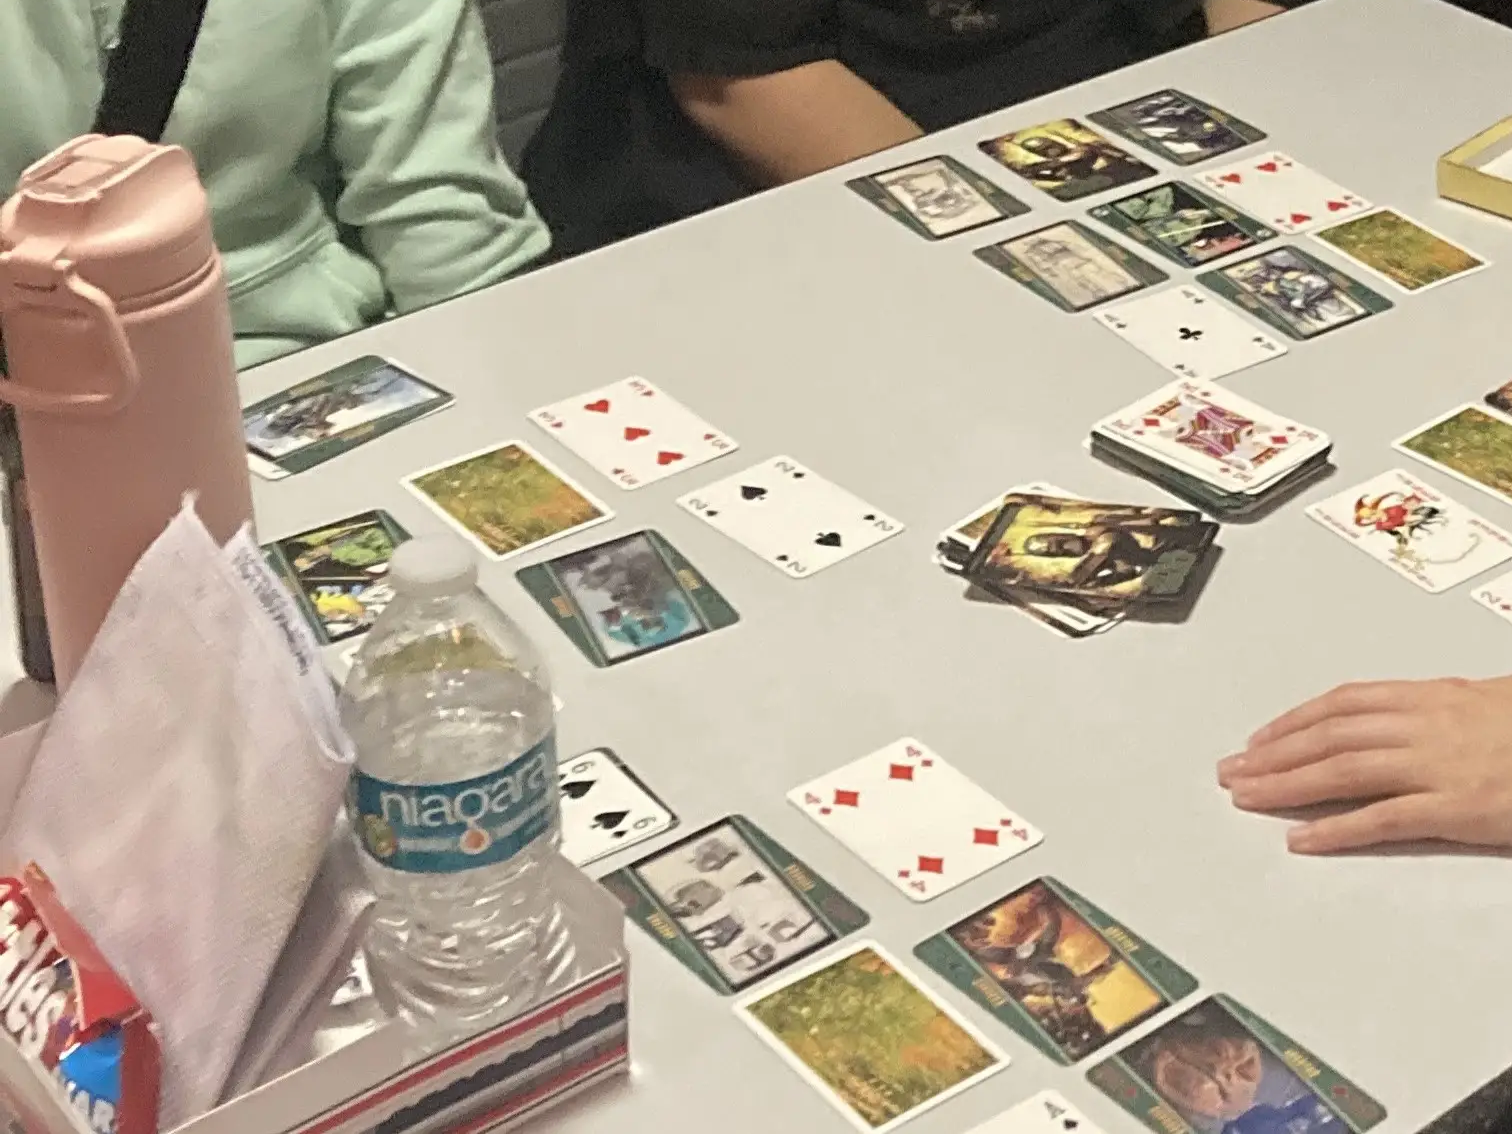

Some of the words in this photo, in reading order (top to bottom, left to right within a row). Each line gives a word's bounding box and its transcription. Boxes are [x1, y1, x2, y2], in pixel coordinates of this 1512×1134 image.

[775, 461, 795, 473] 2
[688, 498, 707, 511] 2
[874, 519, 894, 533] 2
[788, 560, 807, 573] 2
[1480, 591, 1501, 605] 2
[379, 752, 549, 828] niagara
